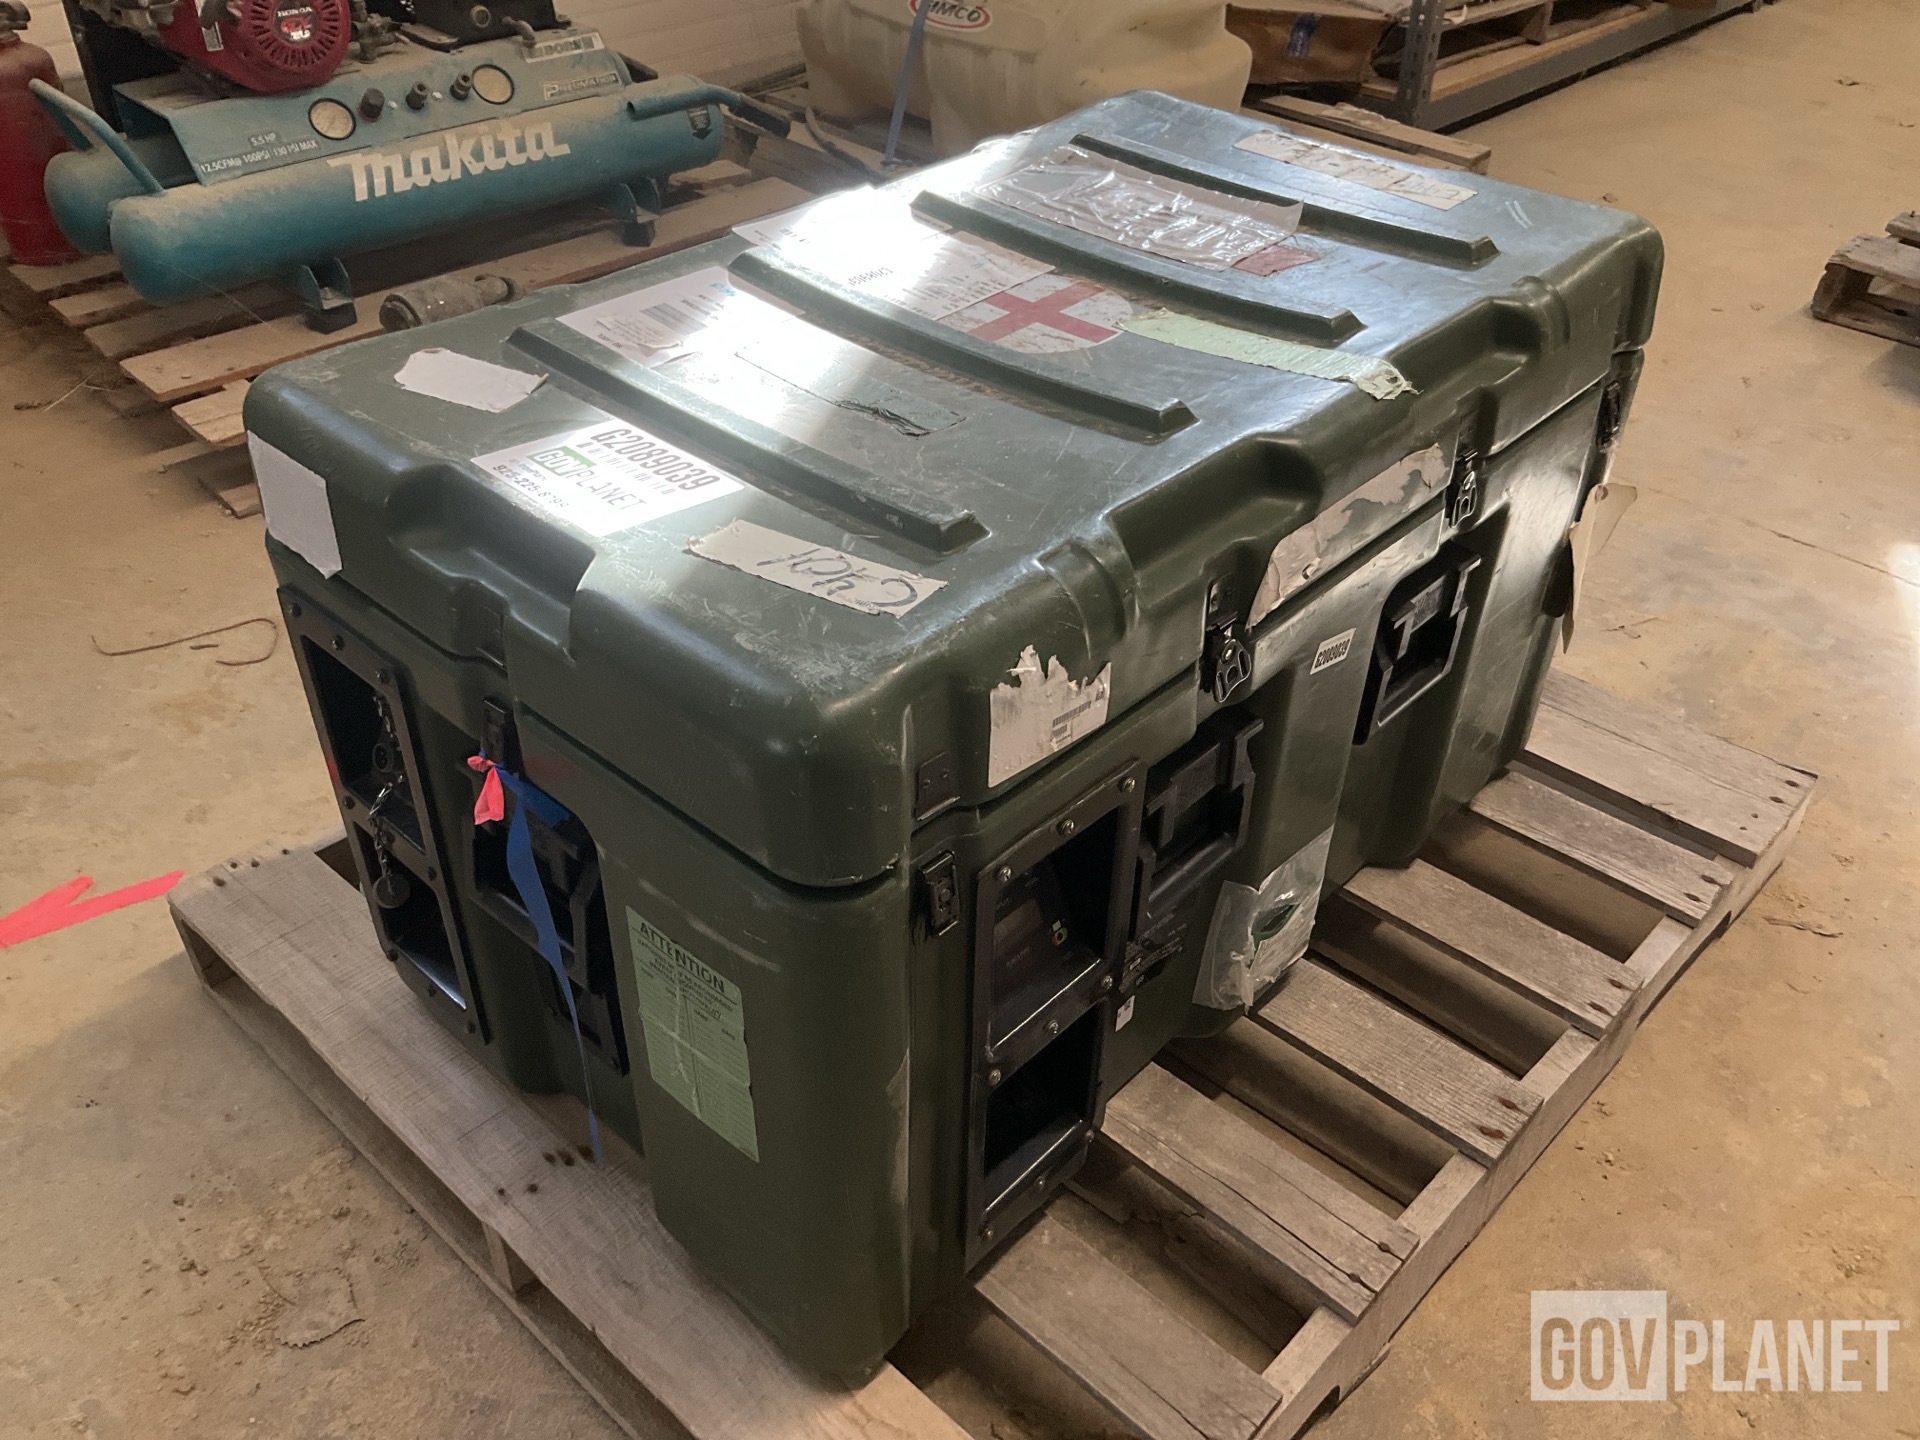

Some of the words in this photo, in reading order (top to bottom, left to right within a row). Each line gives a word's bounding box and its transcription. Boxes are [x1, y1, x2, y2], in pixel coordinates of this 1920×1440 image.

[277, 6, 312, 17] HONDA
[928, 1, 981, 22] IMCO
[250, 137, 264, 147] 5.5
[264, 132, 276, 142] HP
[299, 139, 318, 152] MAX
[590, 428, 721, 491] G2089039
[535, 449, 648, 510] GOVPLANET
[640, 922, 725, 993] ATTENTION
